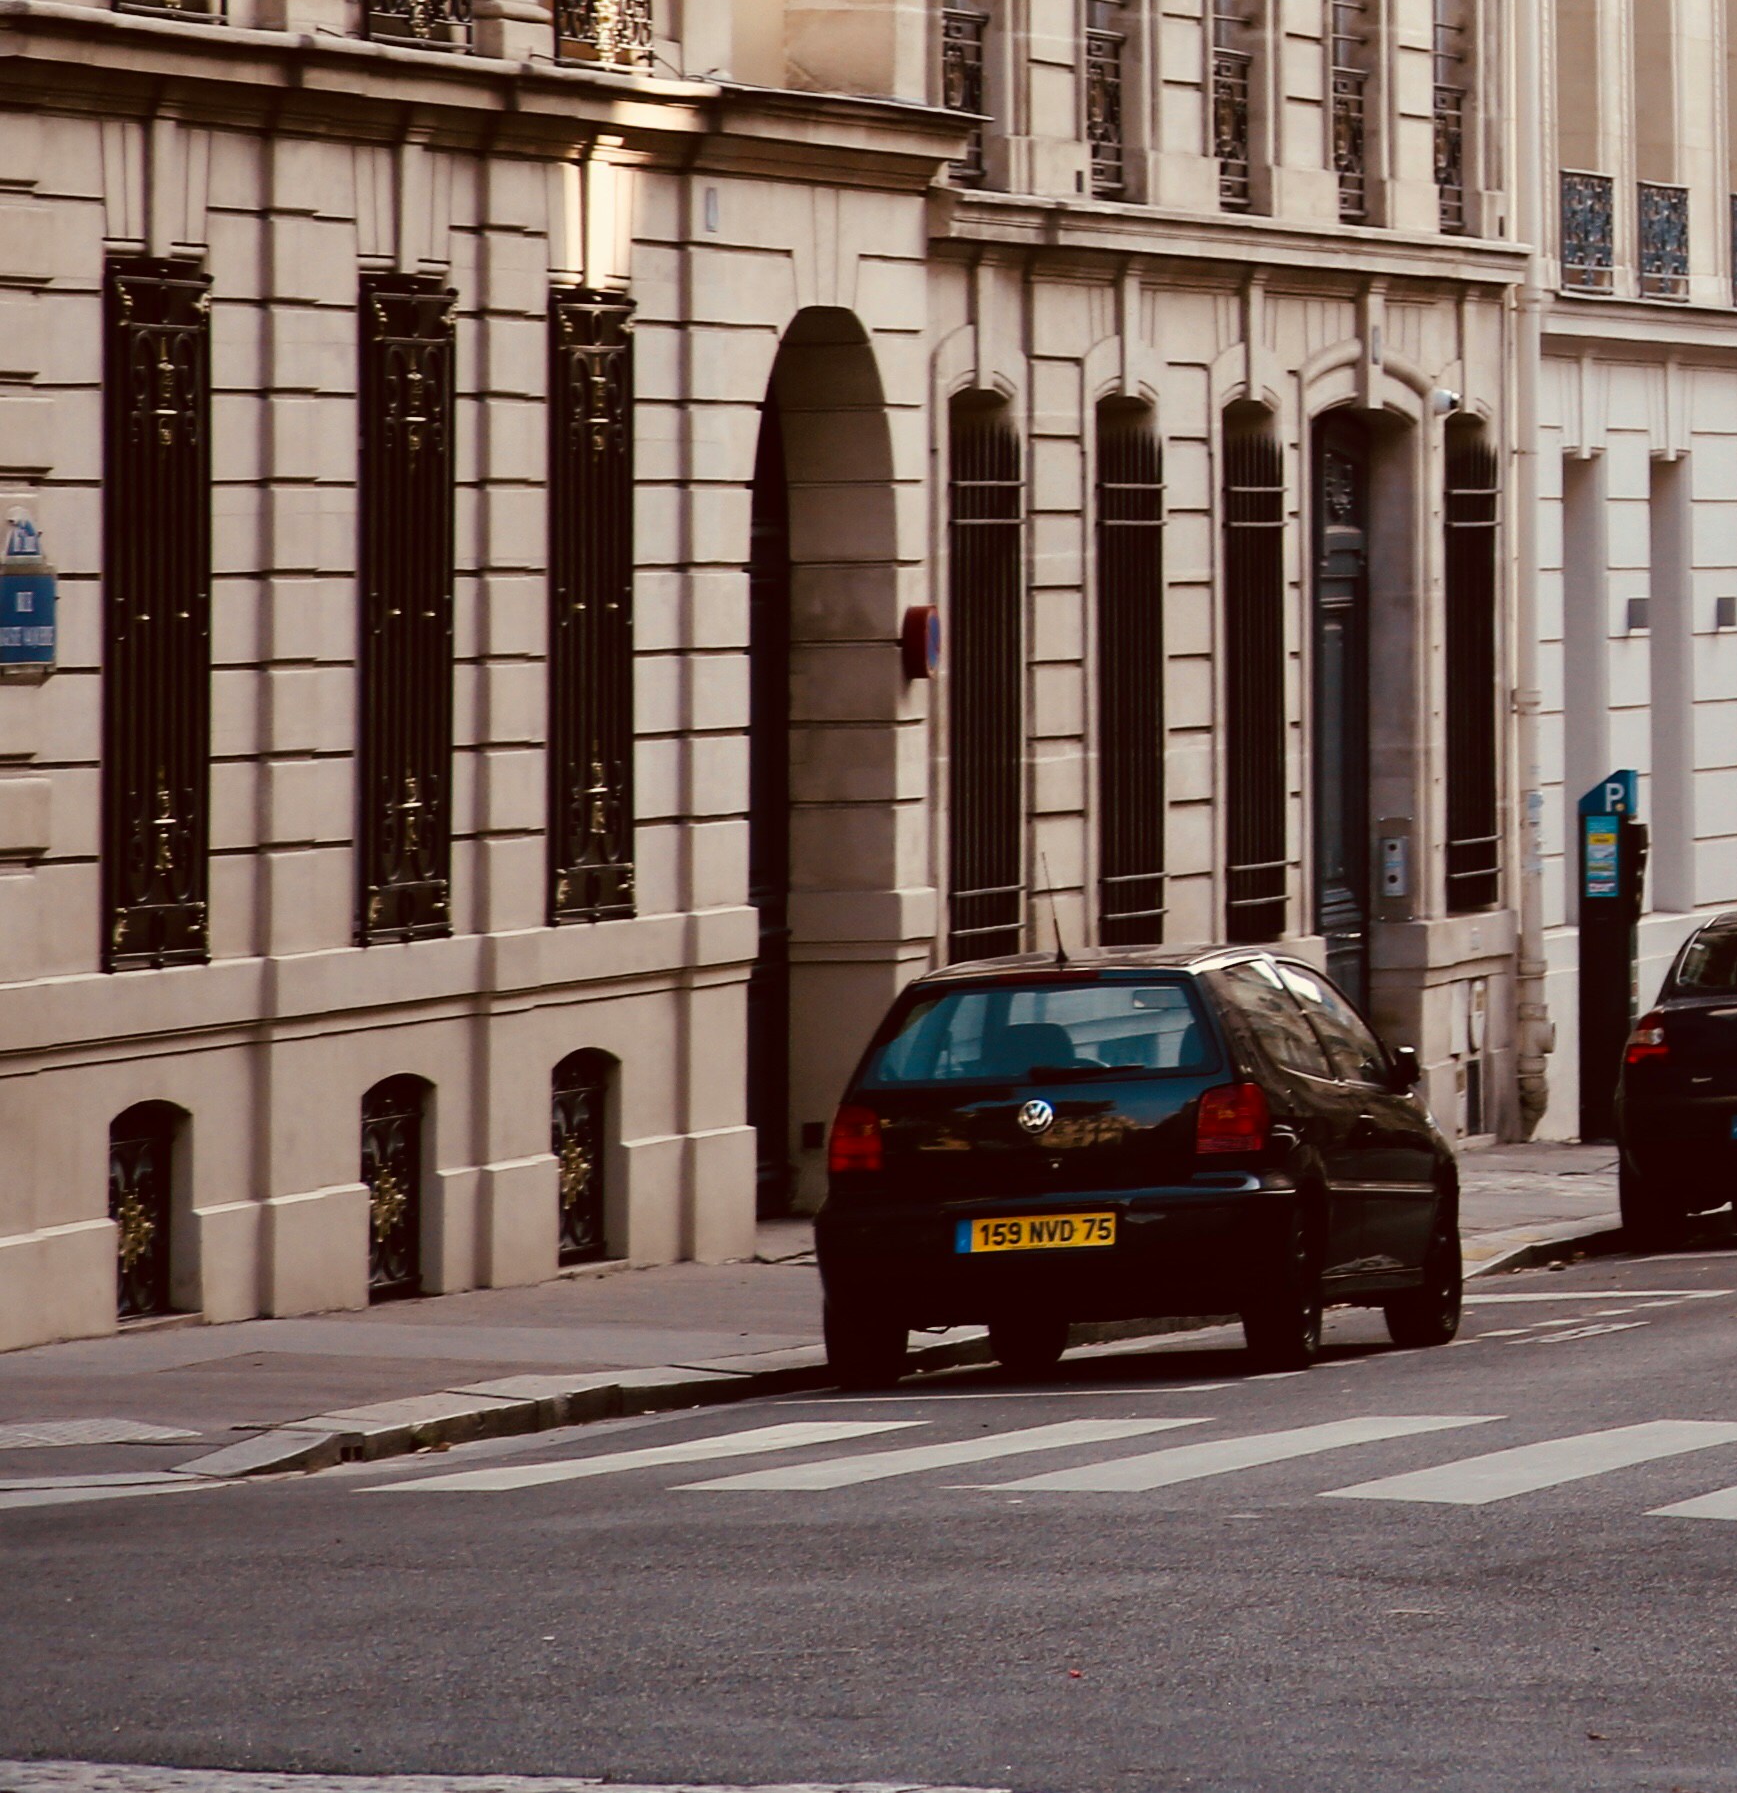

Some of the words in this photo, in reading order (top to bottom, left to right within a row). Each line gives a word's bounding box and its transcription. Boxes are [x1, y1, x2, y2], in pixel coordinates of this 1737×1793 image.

[1605, 782, 1625, 812] P
[980, 1222, 1022, 1246] 159
[1029, 1219, 1075, 1243] NVD
[1082, 1217, 1113, 1240] 75
